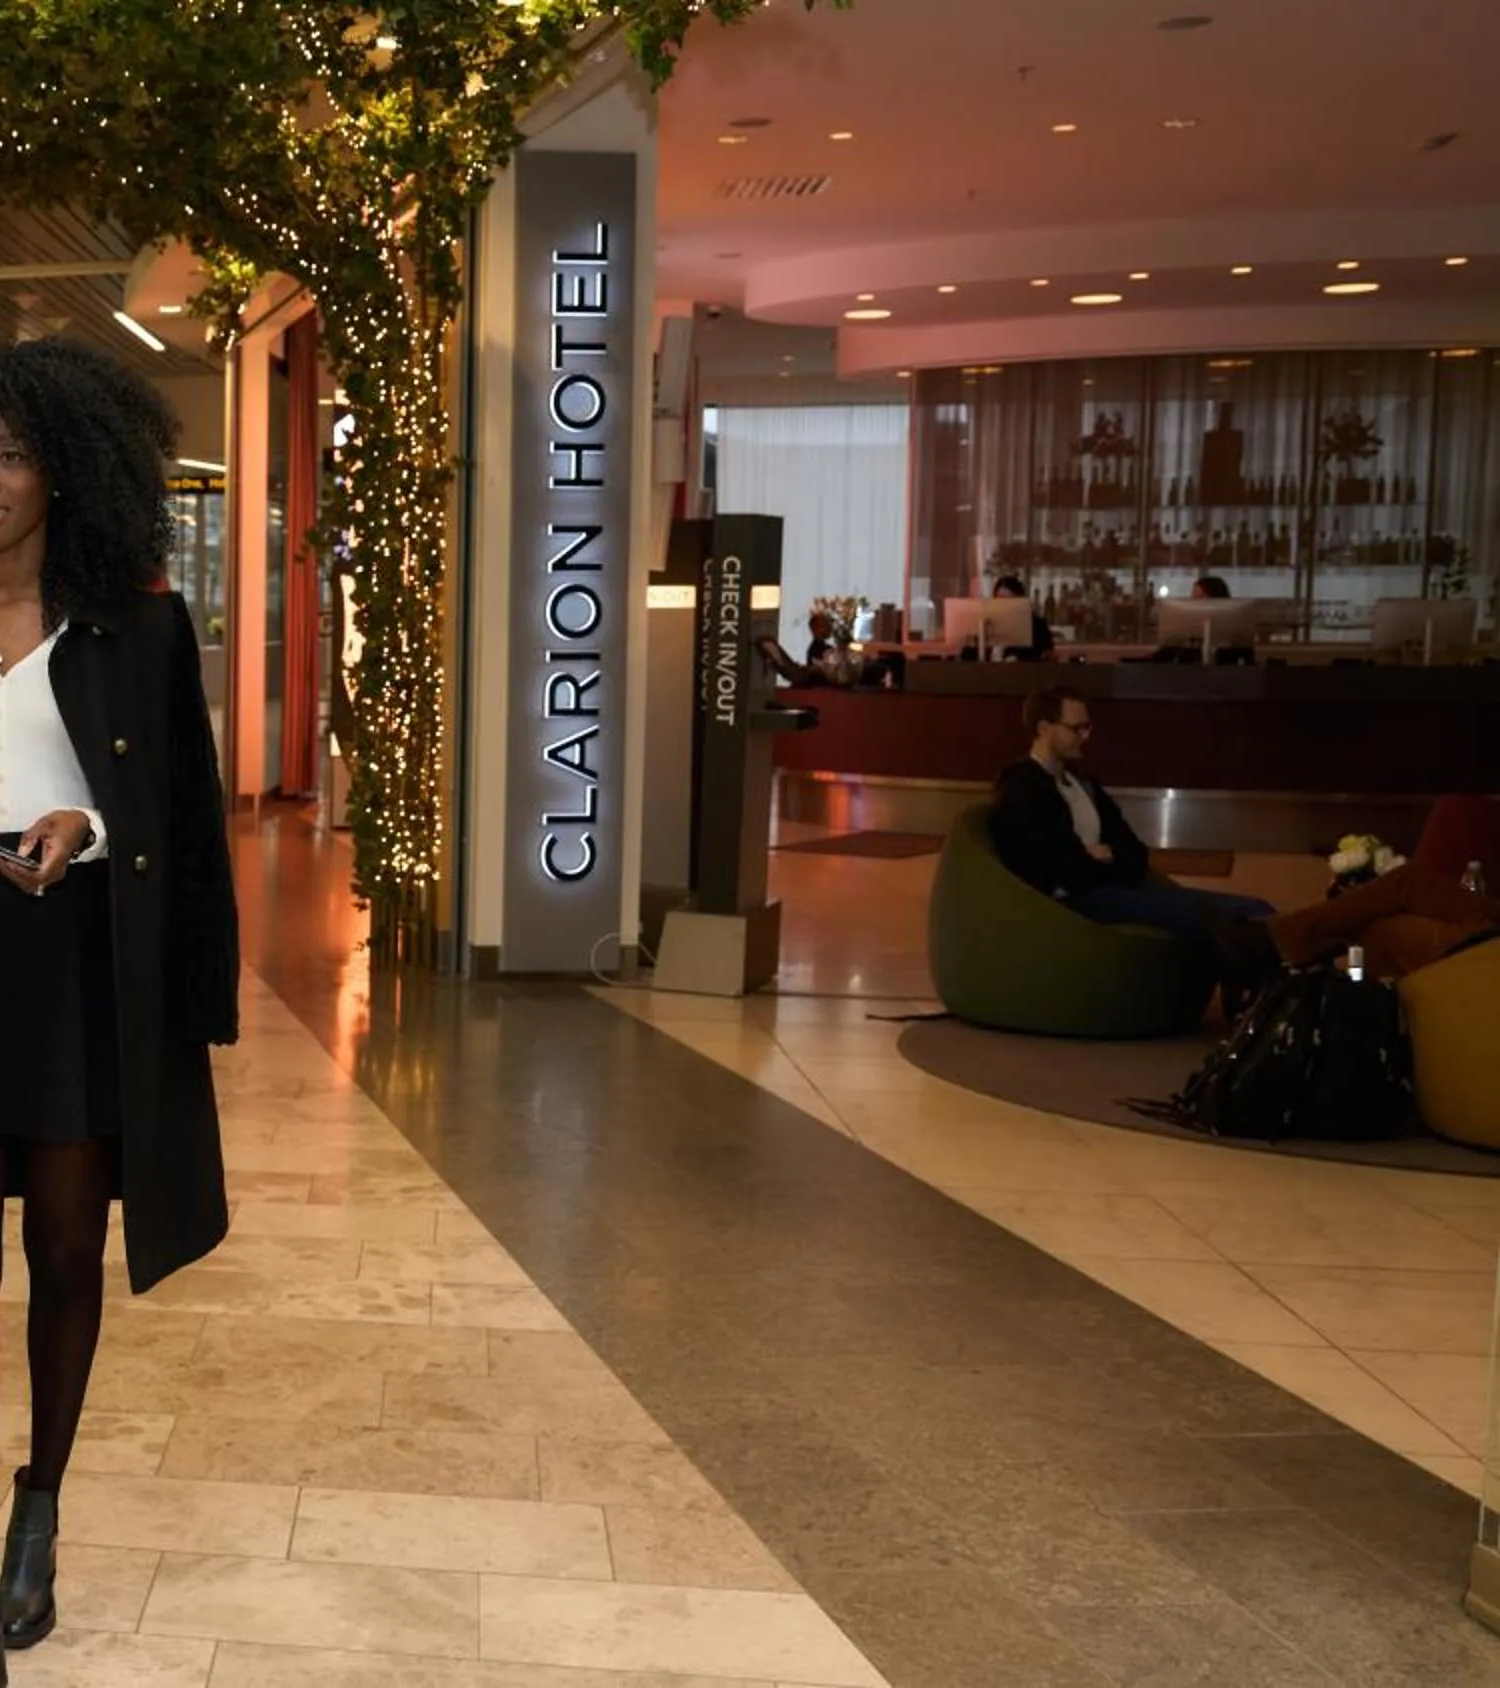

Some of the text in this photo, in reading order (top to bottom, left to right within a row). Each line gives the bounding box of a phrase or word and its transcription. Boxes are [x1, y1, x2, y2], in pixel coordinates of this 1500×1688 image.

[541, 222, 608, 881] CLARION HOTEL
[715, 555, 741, 727] CHECK IN/OUT
